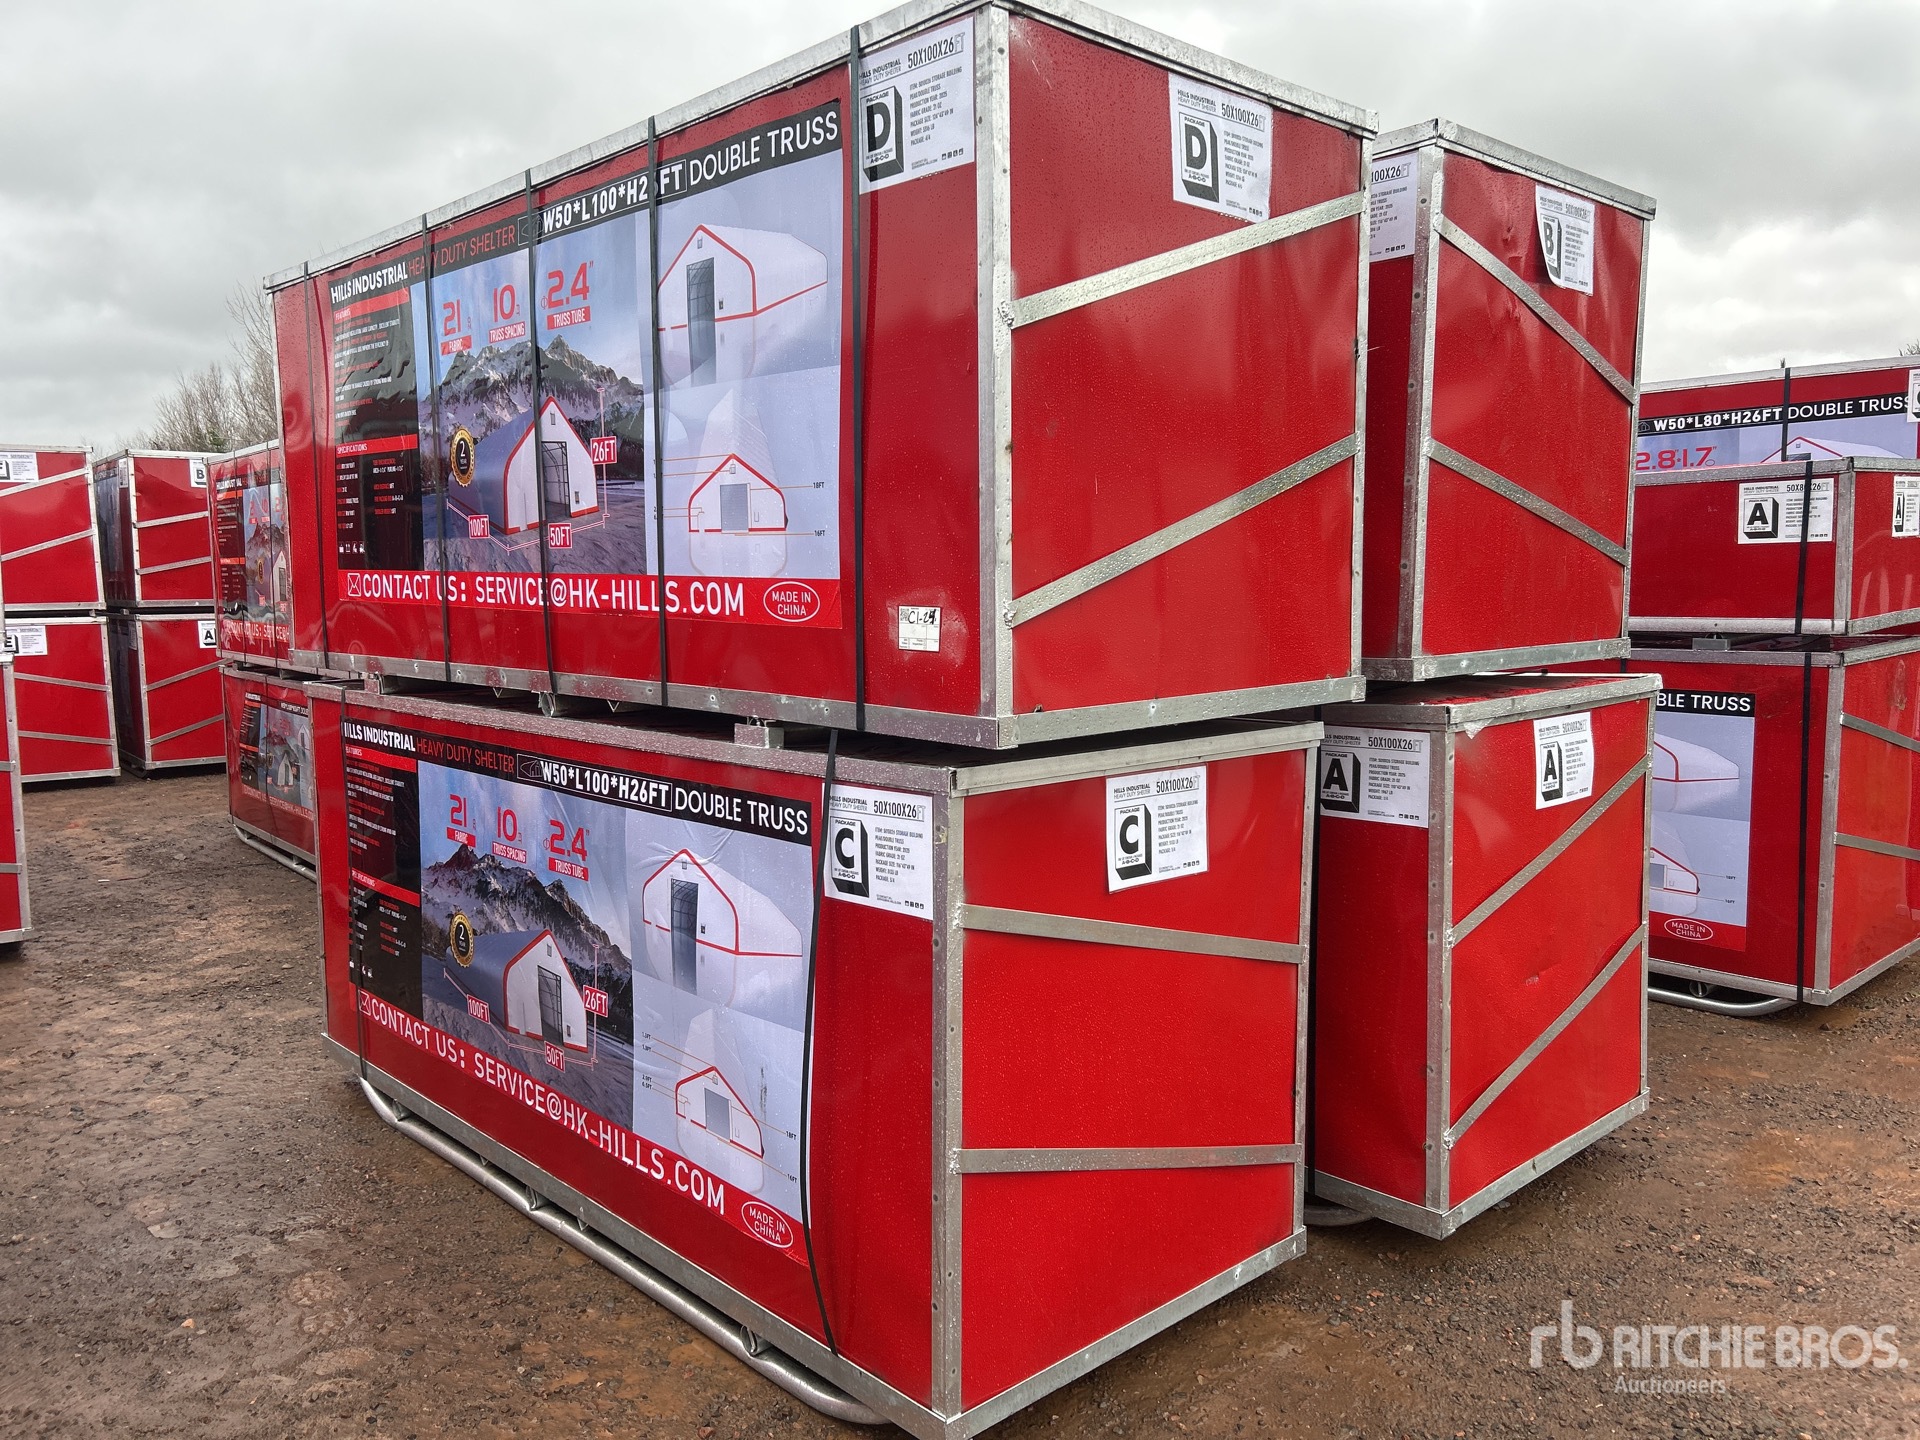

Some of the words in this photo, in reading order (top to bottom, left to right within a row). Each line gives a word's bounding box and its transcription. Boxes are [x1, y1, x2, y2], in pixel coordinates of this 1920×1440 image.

[872, 58, 901, 75] INDUSTRIAL
[873, 72, 884, 82] DUTY
[885, 66, 901, 78] SHELTER
[866, 91, 889, 103] PACKAGE
[1177, 89, 1189, 99] HILLS
[1190, 94, 1216, 106] INDUSTRIAL
[867, 102, 891, 153] D
[1184, 116, 1205, 127] PACKAGE
[1185, 123, 1207, 169] D
[331, 282, 351, 304] HILLS
[352, 261, 408, 295] INDUSTRIAL
[408, 250, 438, 277] HEAY
[441, 241, 467, 266] DUTY
[470, 225, 515, 256] SHELTER
[690, 136, 760, 186] DOUBLE
[767, 111, 838, 158] TRUSS
[1543, 221, 1555, 256] B
[493, 284, 516, 322] 10
[443, 299, 461, 336] 21
[553, 312, 570, 327] TRUSS
[571, 308, 586, 324] TUBE
[490, 328, 504, 343] TRUSS
[505, 323, 524, 340] SPACING
[1788, 401, 1853, 420] DOUBLE
[460, 441, 466, 457] 2
[592, 440, 615, 463] 26FT
[196, 469, 205, 480] B
[813, 481, 824, 489] 18FT
[1747, 503, 1769, 526] A
[1895, 497, 1901, 519] A
[469, 518, 488, 537] 100FT
[550, 526, 570, 547] 50FT
[362, 574, 430, 599] CONTACT
[436, 576, 467, 601] US:
[476, 577, 744, 617] SERVICE@HK-HILLS.COM
[772, 591, 798, 603] MADE
[801, 592, 811, 604] IN
[777, 604, 806, 616] CHINA
[204, 629, 214, 641] A
[1691, 694, 1751, 712] TRUSS
[1323, 758, 1348, 791] A
[1544, 750, 1557, 782] A
[364, 725, 415, 752] INDUSTRIAL
[416, 737, 444, 758] HEAVY
[446, 743, 472, 764] DUTY
[474, 749, 514, 774] SHELTER
[675, 787, 741, 822] DOUBLE
[747, 800, 808, 836] TRUSS
[1114, 786, 1125, 794] HILLS
[1126, 783, 1150, 792] INDUSTRIAL
[842, 797, 867, 806] INDUSTRIAL
[1114, 791, 1125, 799] HEAVY
[1126, 790, 1136, 798] DUTY
[450, 794, 467, 828] 21
[497, 806, 517, 842] 10
[1120, 815, 1139, 854] C
[493, 842, 506, 857] TRUSS
[506, 846, 526, 863] SPACING
[835, 828, 854, 869] C
[555, 860, 571, 876] TRUSS
[572, 864, 585, 879] TUBE
[459, 924, 465, 940] 2
[1671, 921, 1694, 931] MADE
[1676, 928, 1701, 938] CHINA
[468, 998, 488, 1022] 100FT
[585, 989, 607, 1014] 26FT
[546, 1044, 564, 1071] 50FT
[371, 998, 430, 1050] CONTACT
[435, 1032, 465, 1069] US:
[474, 1052, 724, 1216] SERVICE@HK-HILLS.COM
[786, 1130, 797, 1141] 18FT
[787, 1174, 797, 1183] 16FT
[749, 1206, 774, 1227] MADE
[776, 1220, 786, 1234] IN
[754, 1217, 781, 1243] CHINA
